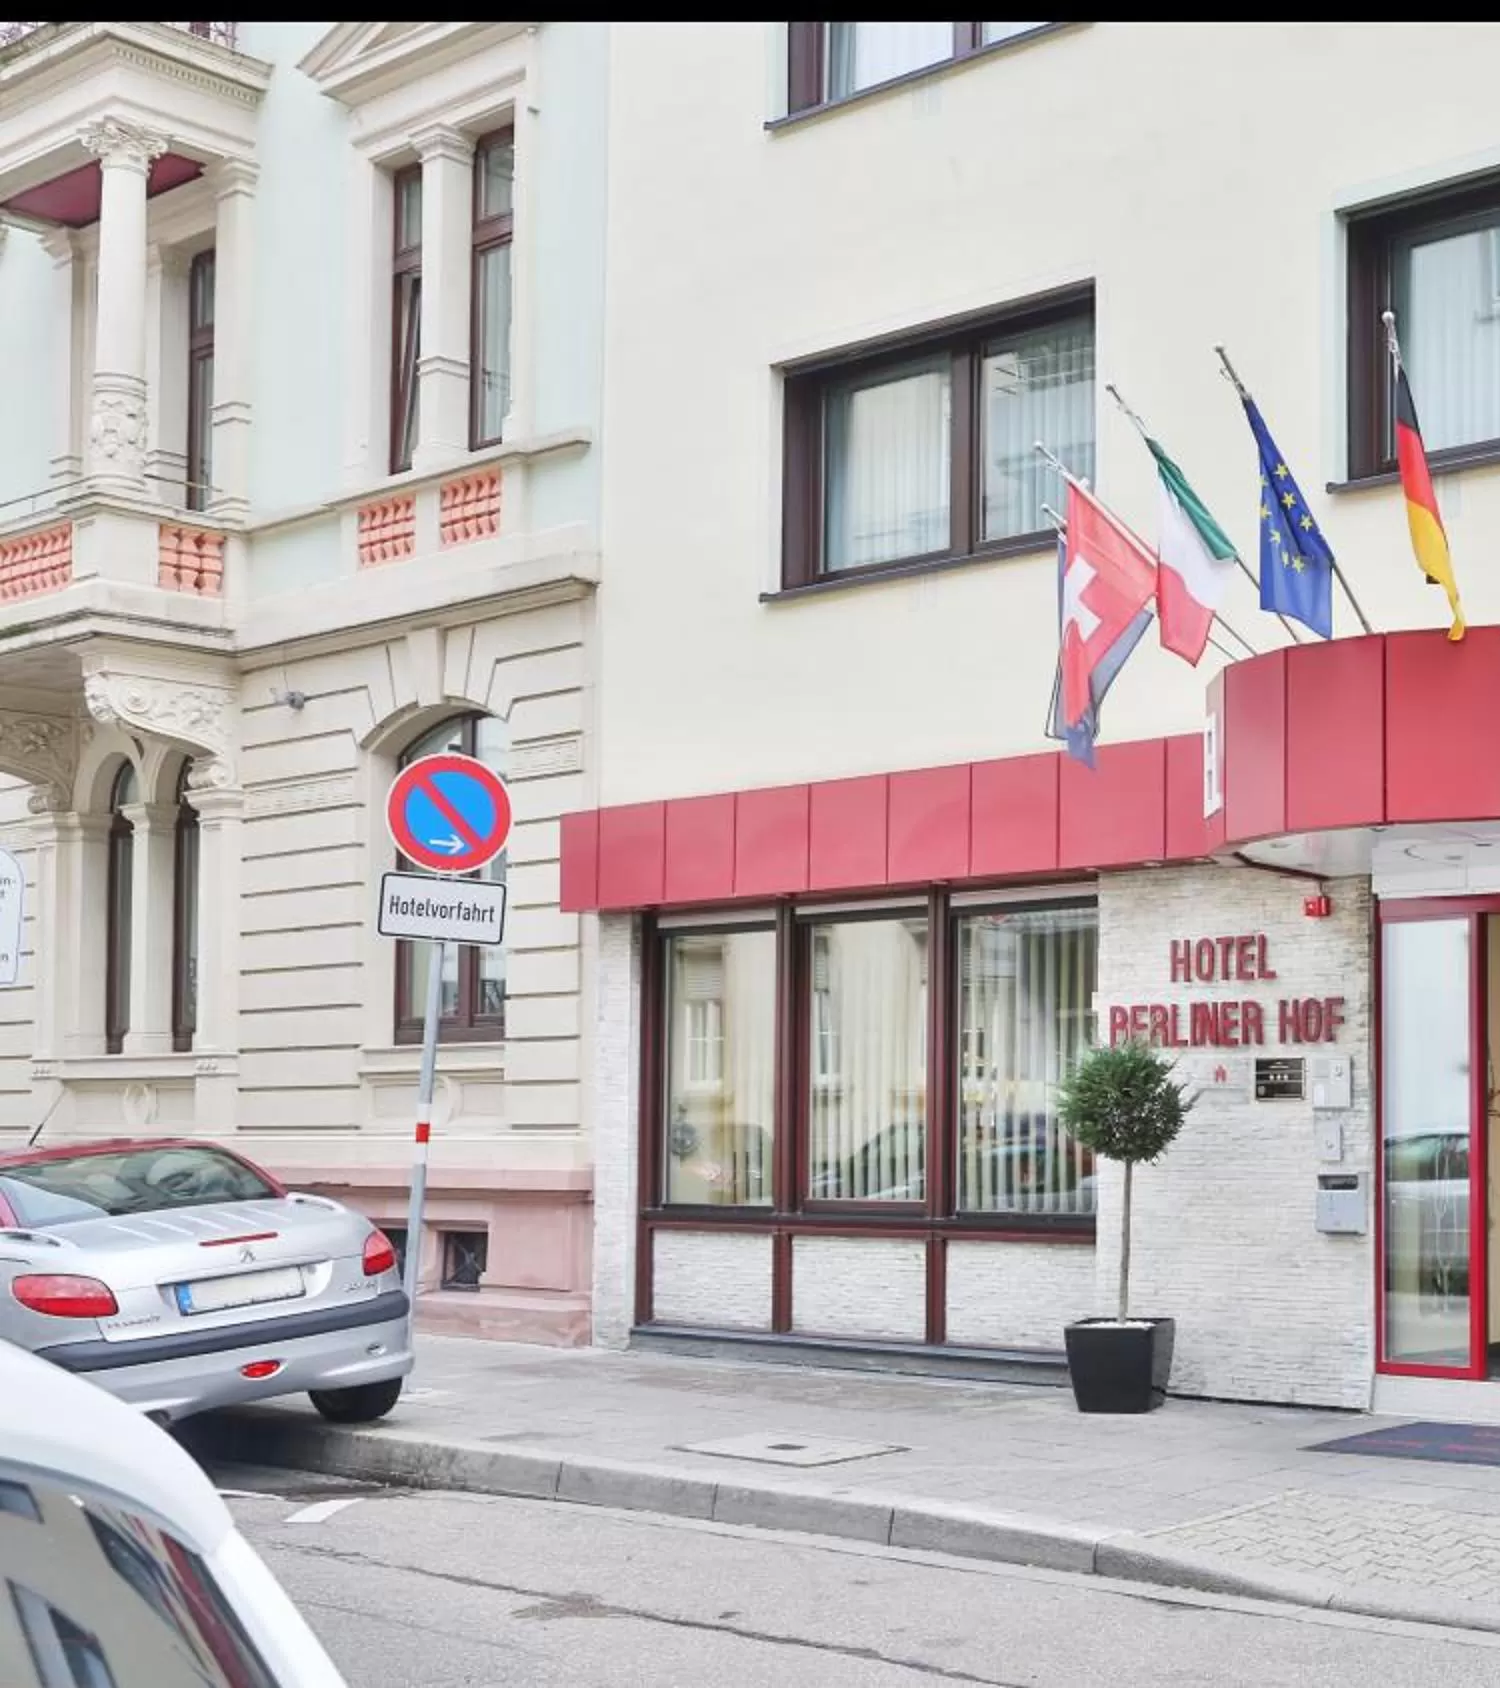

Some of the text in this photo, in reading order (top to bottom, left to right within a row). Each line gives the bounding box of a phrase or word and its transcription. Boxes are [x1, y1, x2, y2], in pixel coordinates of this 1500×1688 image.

[389, 895, 495, 923] Hotelvorfahrt
[1170, 934, 1277, 983] HOTEL
[1109, 997, 1345, 1048] BERLINER HOF
